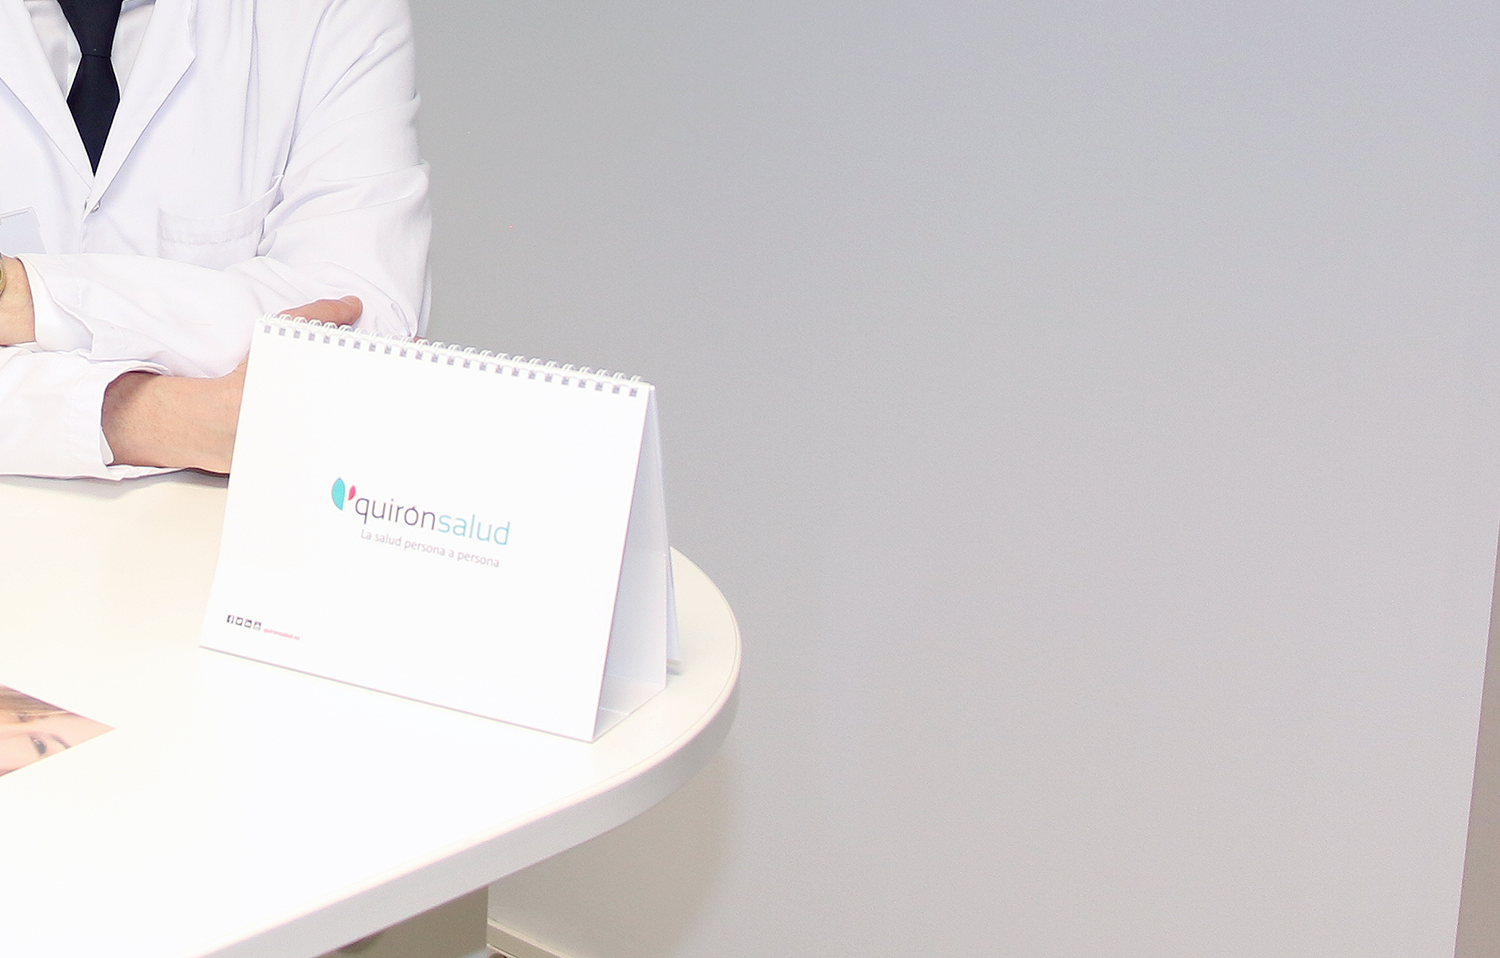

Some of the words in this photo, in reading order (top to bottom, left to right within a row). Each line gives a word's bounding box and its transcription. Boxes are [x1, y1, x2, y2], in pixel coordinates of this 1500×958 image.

[355, 497, 511, 545] quirónsalud
[361, 529, 372, 540] La
[374, 533, 402, 547] salud
[404, 539, 446, 557] persona
[448, 548, 454, 558] a
[457, 551, 500, 568] persona
